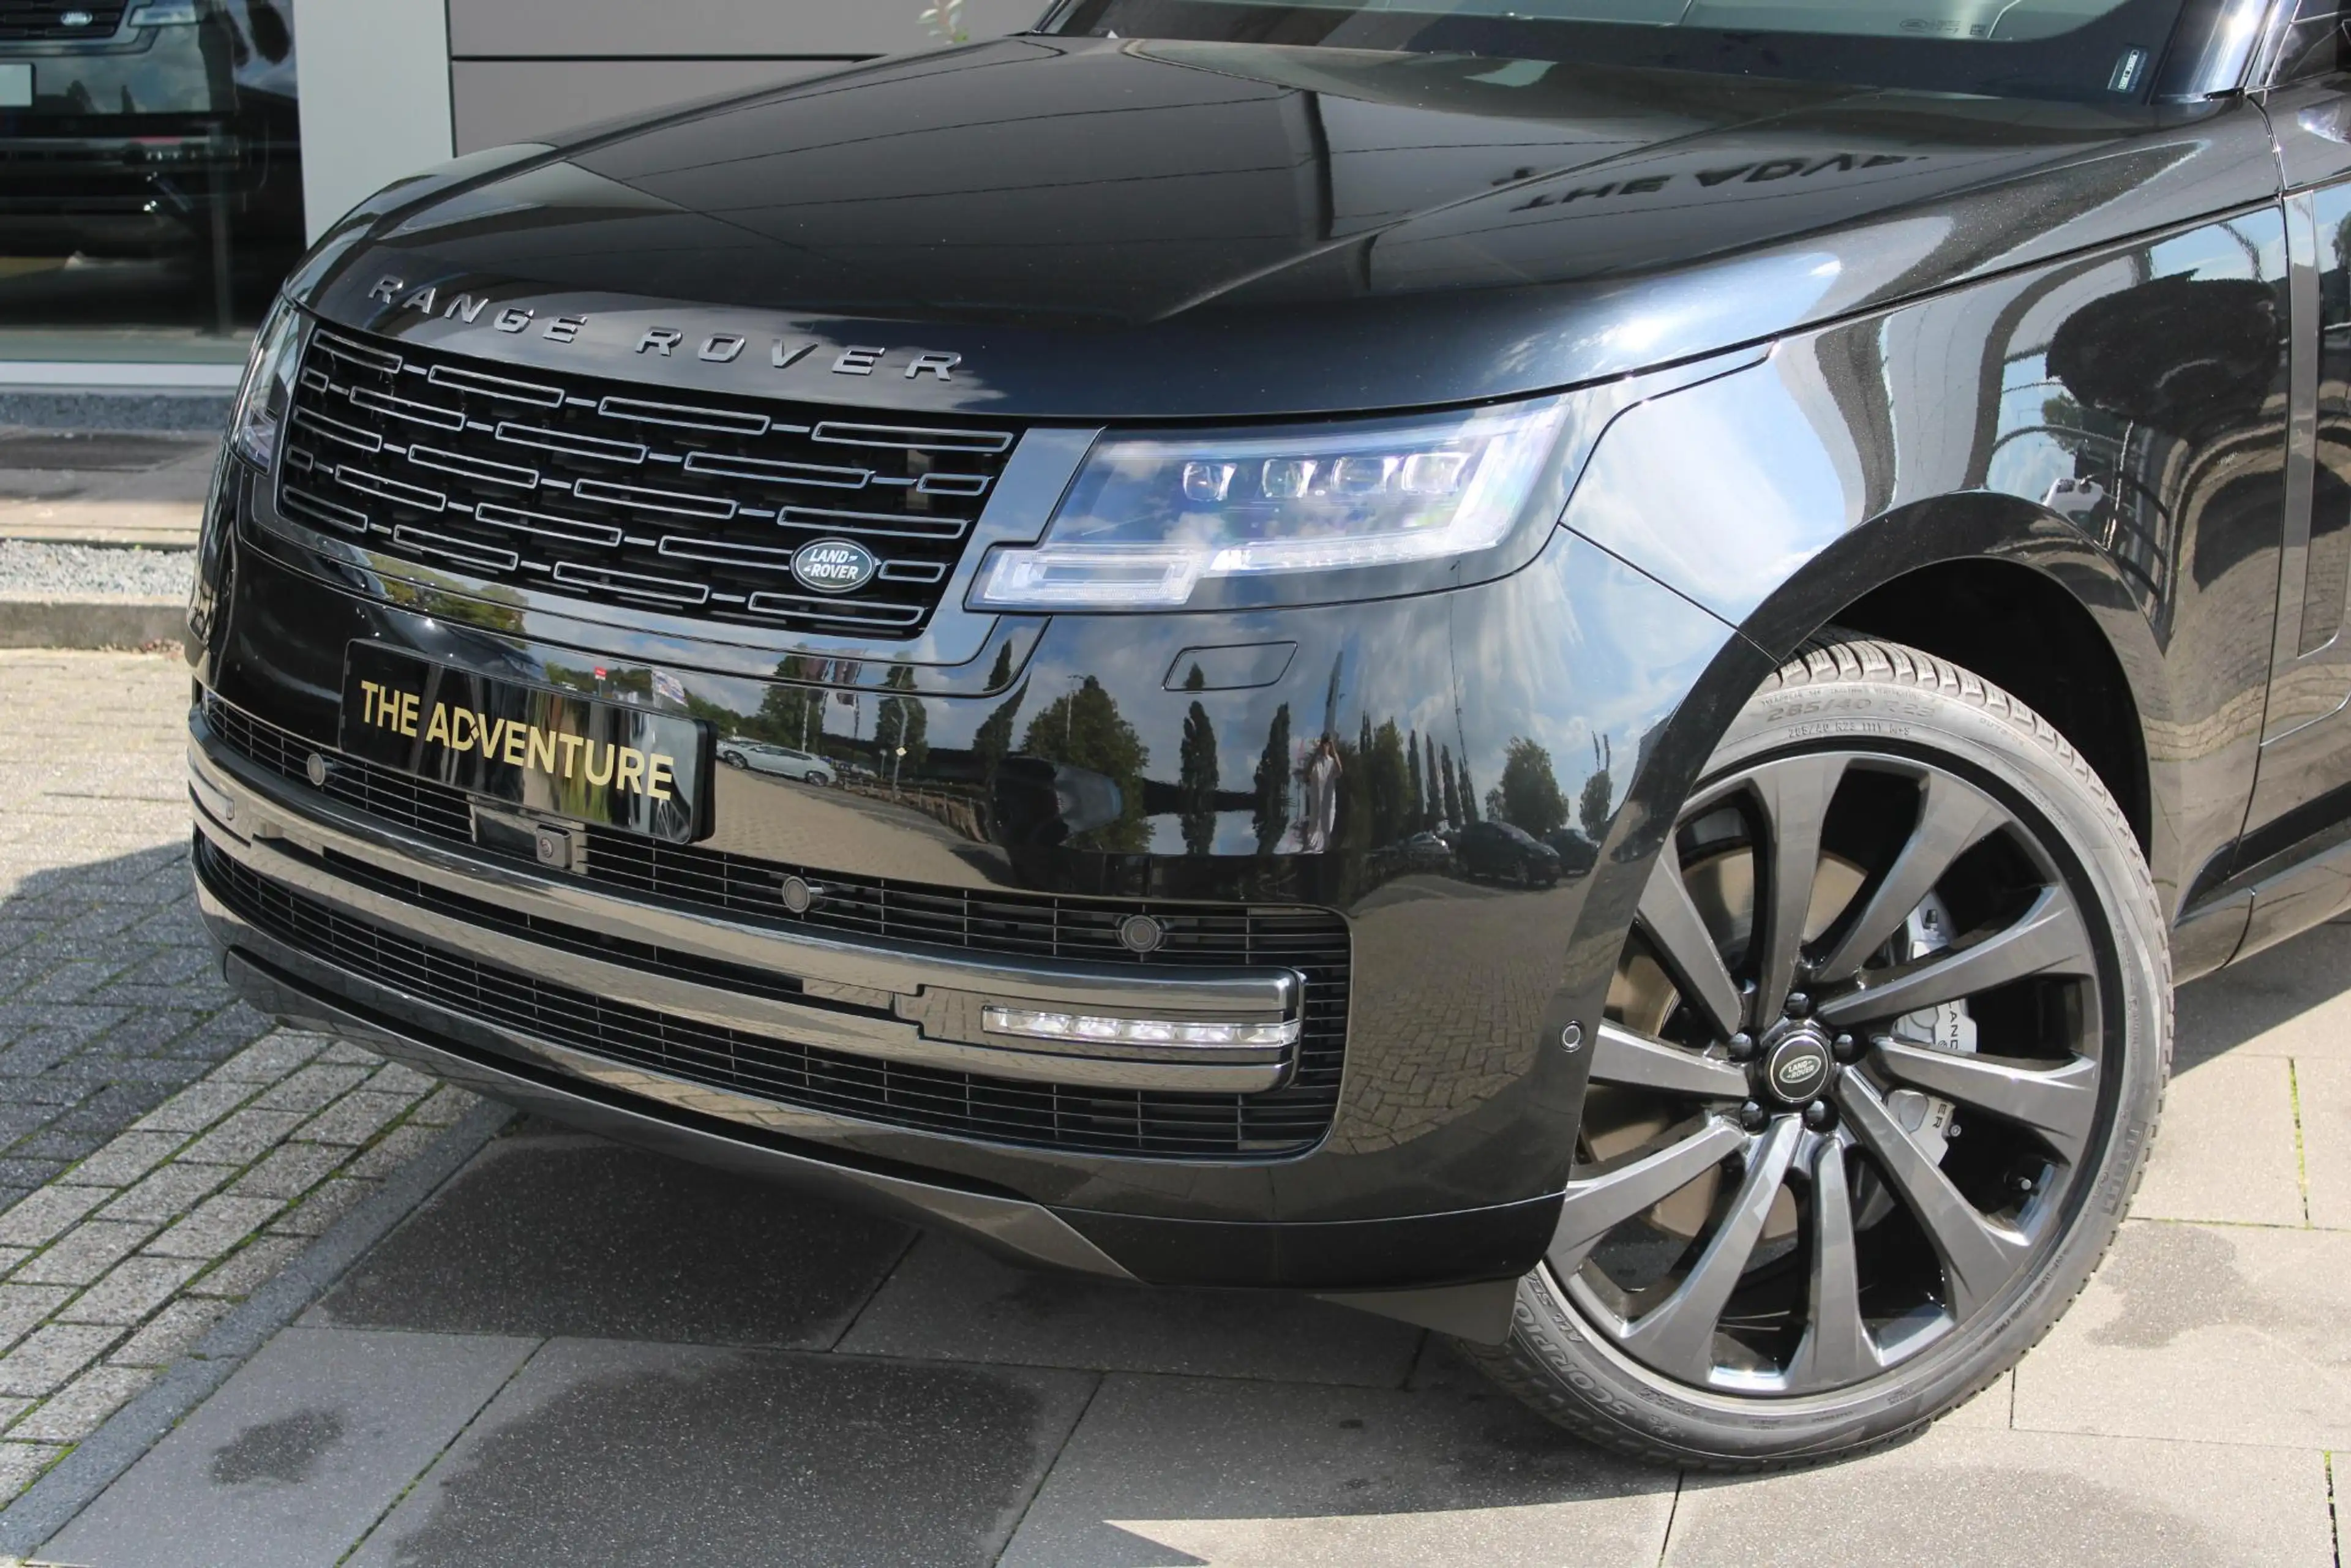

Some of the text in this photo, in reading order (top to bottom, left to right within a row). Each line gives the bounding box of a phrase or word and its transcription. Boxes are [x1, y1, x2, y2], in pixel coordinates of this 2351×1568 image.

[367, 273, 963, 383] RANGE ROVER
[809, 548, 850, 563] LAND
[809, 563, 860, 580] ROVER
[361, 680, 674, 801] THE ADVENTURE
[1515, 1296, 1638, 1416] SCORPIO
[1551, 1312, 1583, 1343] ALL
